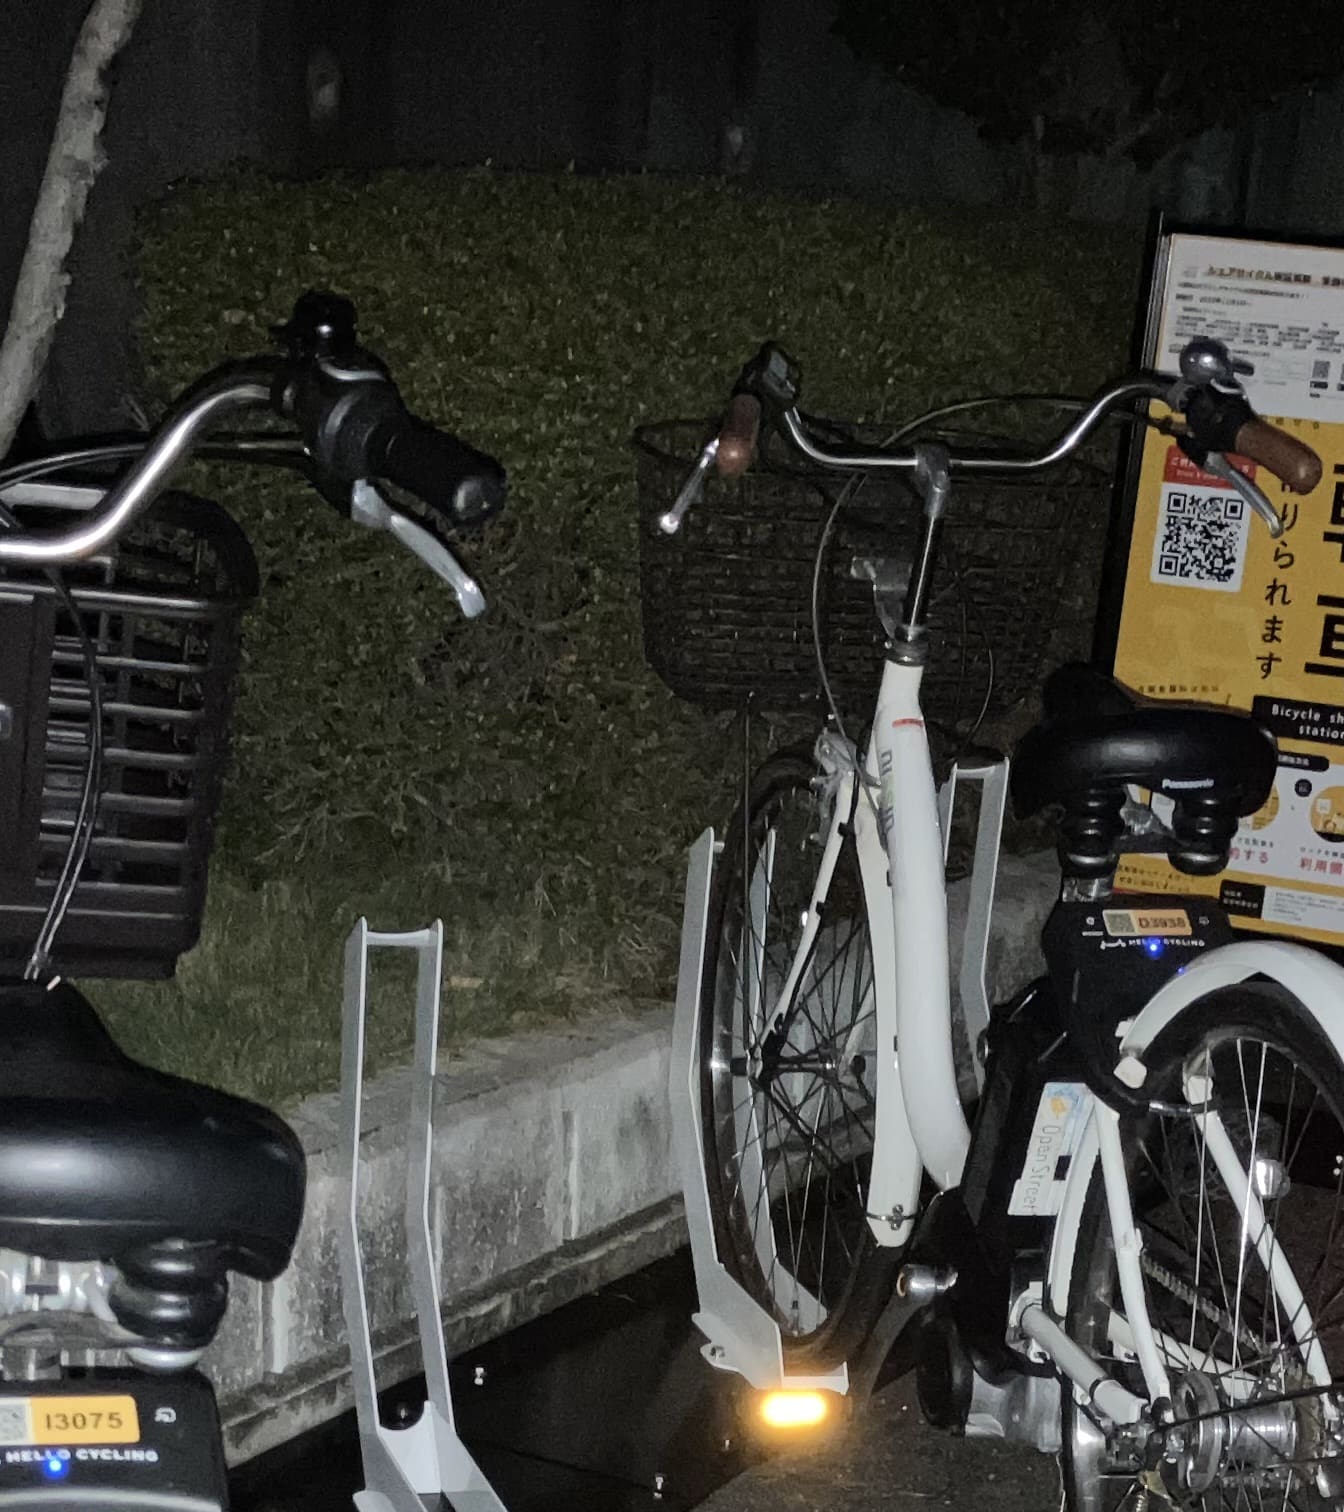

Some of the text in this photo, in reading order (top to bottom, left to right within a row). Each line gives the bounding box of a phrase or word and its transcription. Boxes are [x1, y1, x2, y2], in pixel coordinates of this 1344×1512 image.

[1256, 482, 1298, 680] りられます
[1271, 703, 1321, 721] Bicycle
[6, 1448, 160, 1464] HELLO CYCLING
